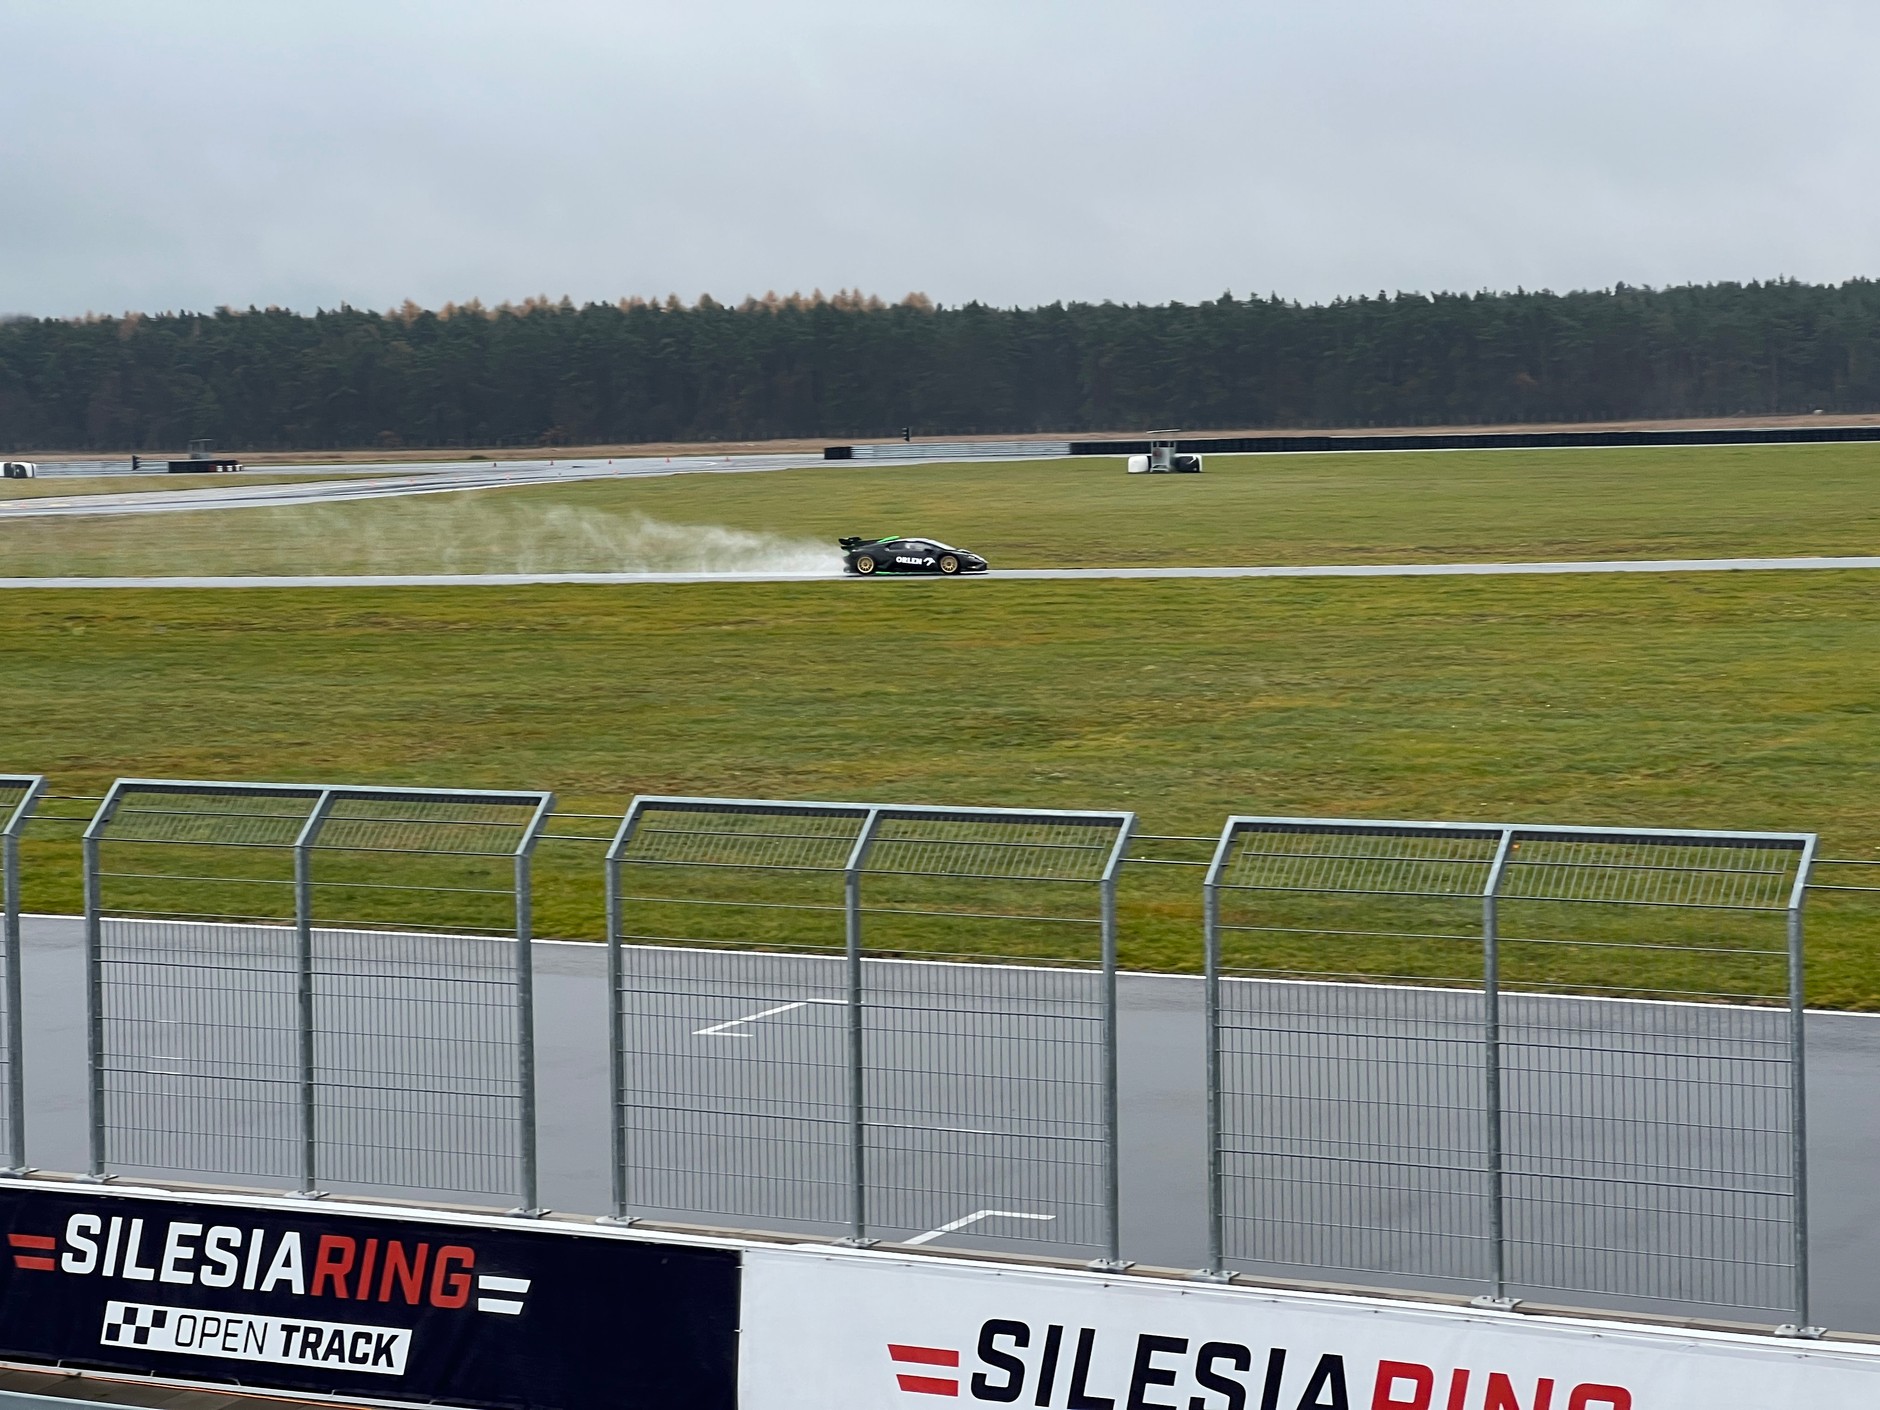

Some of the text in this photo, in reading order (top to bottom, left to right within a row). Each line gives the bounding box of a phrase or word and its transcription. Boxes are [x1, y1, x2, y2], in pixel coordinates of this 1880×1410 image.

[895, 556, 922, 565] ORLEN
[62, 1213, 475, 1309] SILESIARING
[174, 1313, 400, 1368] OPEN TRACK
